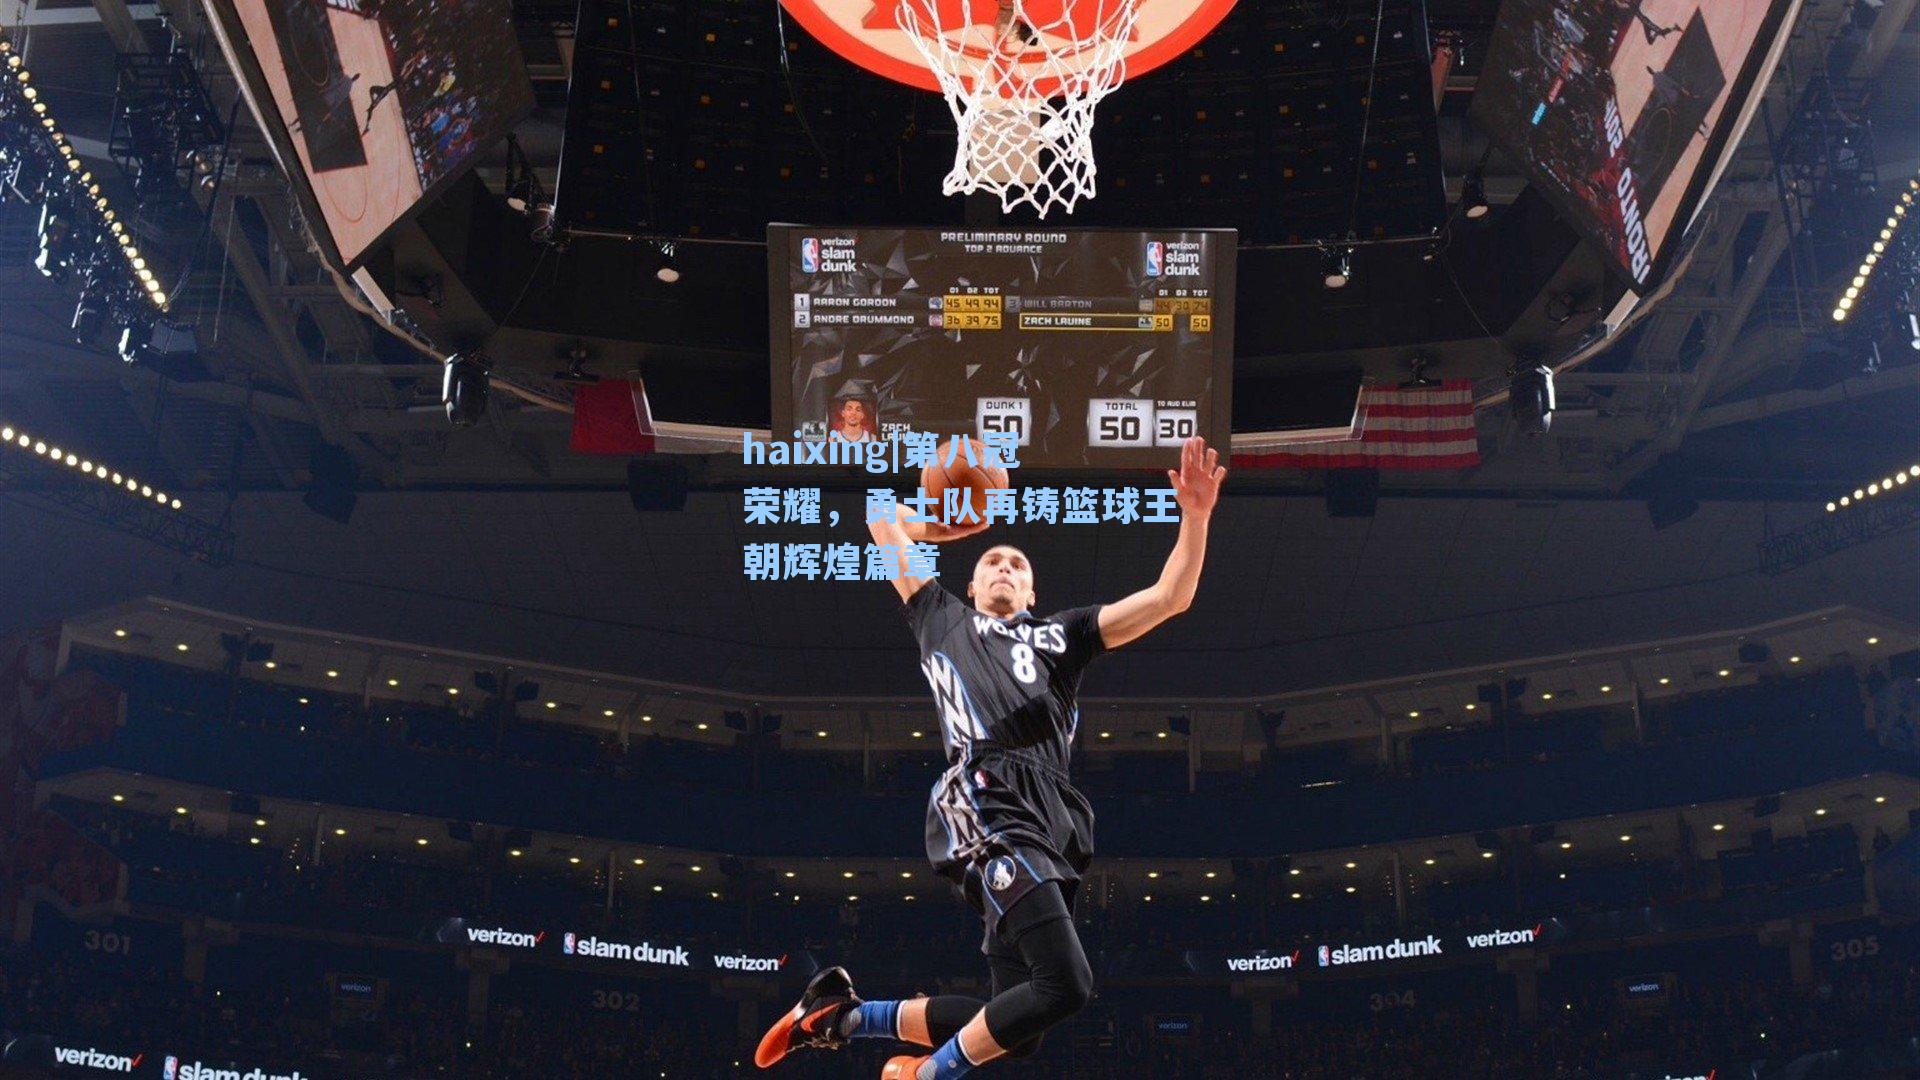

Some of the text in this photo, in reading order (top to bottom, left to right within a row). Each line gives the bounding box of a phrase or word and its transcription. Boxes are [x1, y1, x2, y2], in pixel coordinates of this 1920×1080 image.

[821, 237, 856, 246] verizon
[941, 232, 1067, 244] PRELIMINARY ROUND
[964, 245, 1043, 254] TOP 2 ADVANCE
[1165, 241, 1200, 250] verizon
[821, 247, 855, 259] slam
[1165, 251, 1200, 263] slam
[821, 260, 857, 272] dunk
[1165, 263, 1200, 276] dunk
[800, 297, 999, 308] 1 AARON GORDON 45 49 94
[1024, 300, 1048, 308] WILL
[1050, 300, 1092, 309] BARTON
[799, 315, 806, 324] 2
[813, 315, 850, 323] ANDRE
[853, 315, 915, 324] DRUMMOND
[965, 316, 980, 325] 39
[984, 316, 999, 325] 75
[1024, 317, 1209, 328] ZACH LAVINE 50 50
[986, 401, 1023, 410] DUNK 1
[1105, 402, 1139, 411] TOTAL
[881, 423, 911, 431] ZACH
[1100, 416, 1141, 441] 50
[1159, 418, 1194, 438] 30
[972, 616, 1068, 653] WOLVES
[1011, 643, 1037, 684] 8
[84, 930, 132, 955] 301
[1831, 935, 1880, 961] 305
[467, 927, 780, 971] verizon slam dunk verizon
[1226, 929, 1535, 971] verizon slam dunk verizon
[1628, 982, 1660, 992] verizon
[592, 989, 640, 1011] 302
[54, 1046, 132, 1072] verizon
